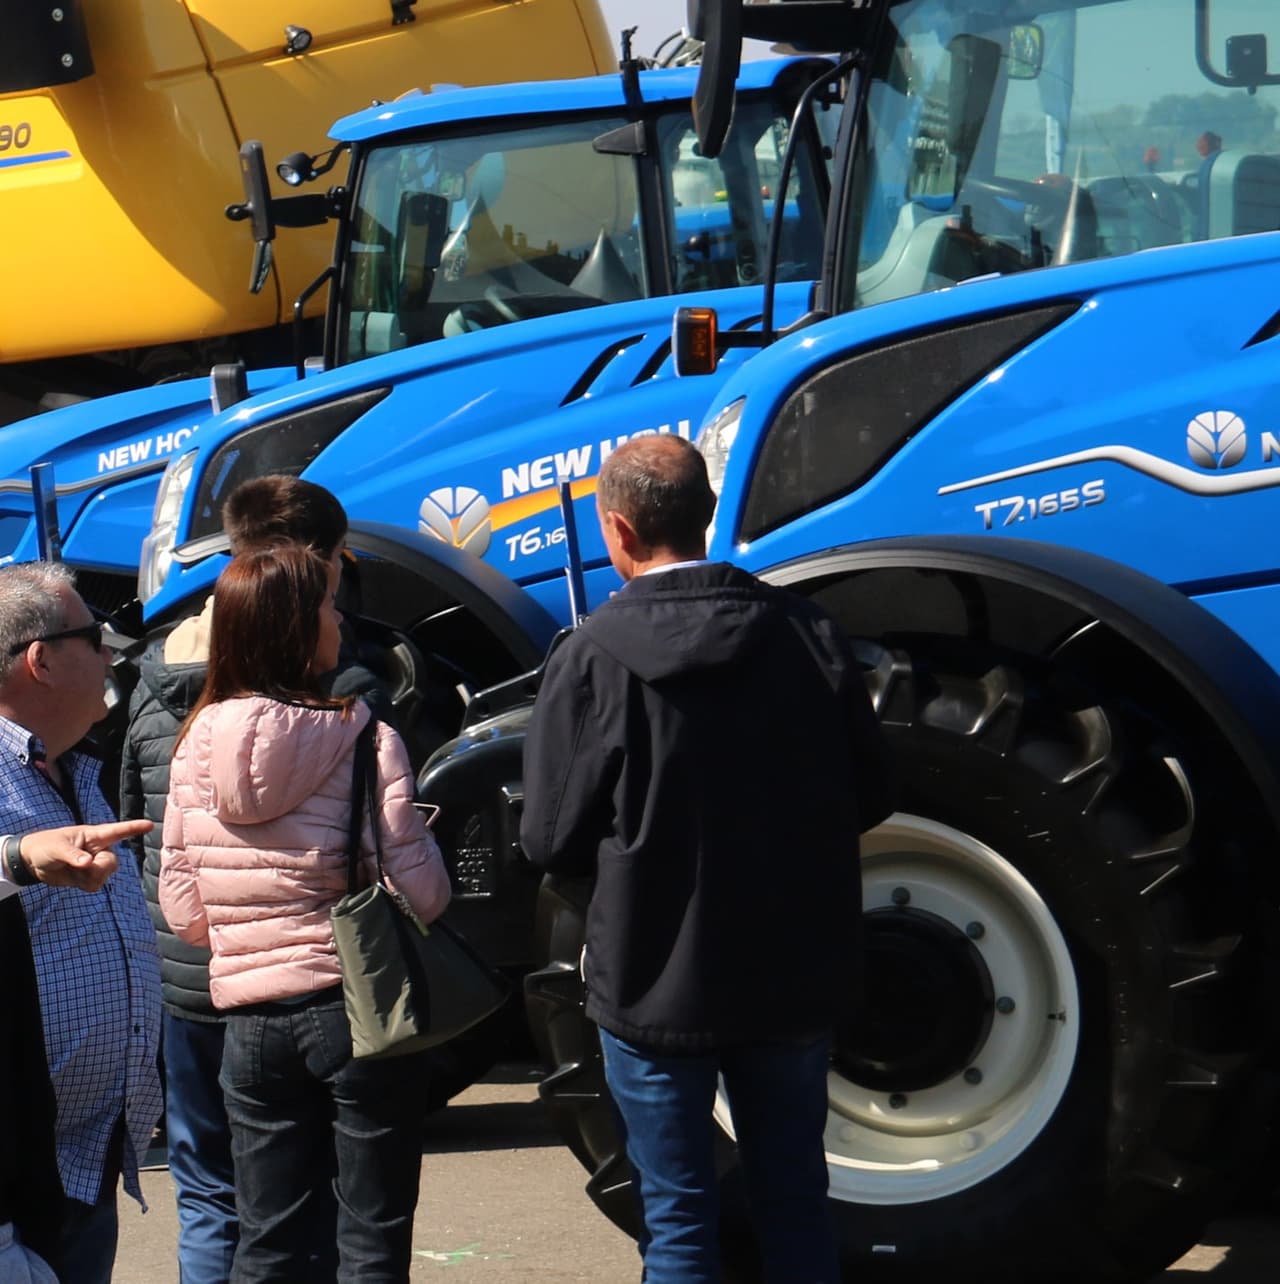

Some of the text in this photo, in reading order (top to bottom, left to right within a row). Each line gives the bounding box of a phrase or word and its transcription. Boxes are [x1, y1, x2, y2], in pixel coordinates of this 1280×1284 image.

[98, 440, 153, 472] NEW
[502, 445, 592, 498] NEW
[974, 479, 1105, 530] T7.165S
[505, 526, 567, 561] T6.16
